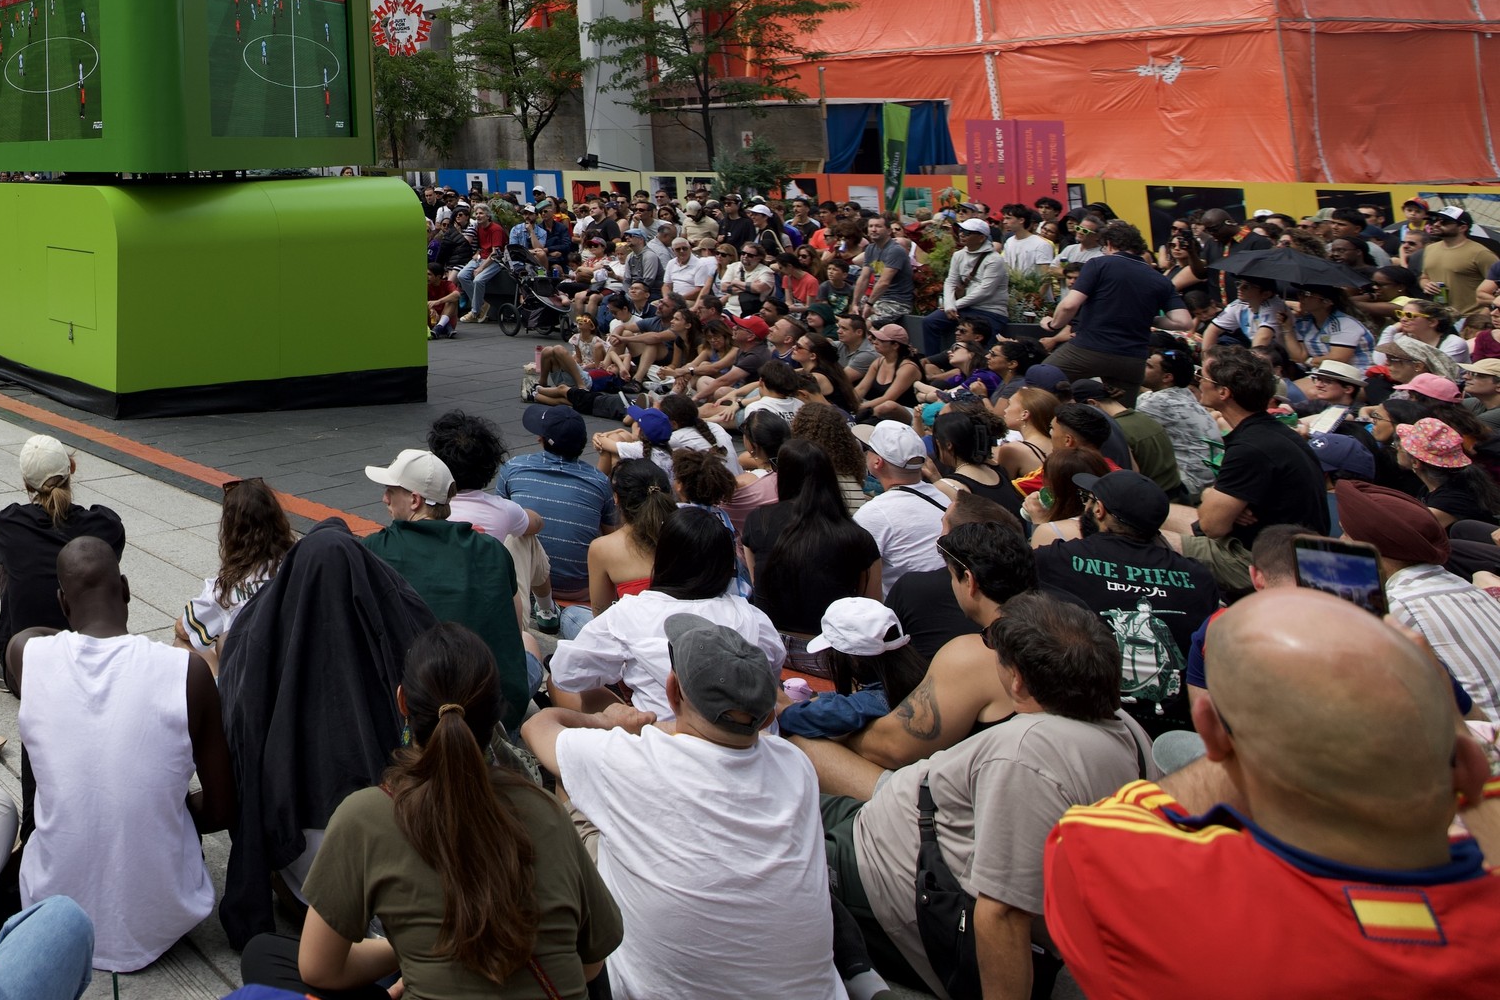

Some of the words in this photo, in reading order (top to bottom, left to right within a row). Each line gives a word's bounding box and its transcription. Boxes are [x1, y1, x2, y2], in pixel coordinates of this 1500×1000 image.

[1071, 555, 1119, 579] ONE
[1124, 565, 1196, 589] PIECE
[1106, 580, 1168, 597] ロロノア・ゾロ
